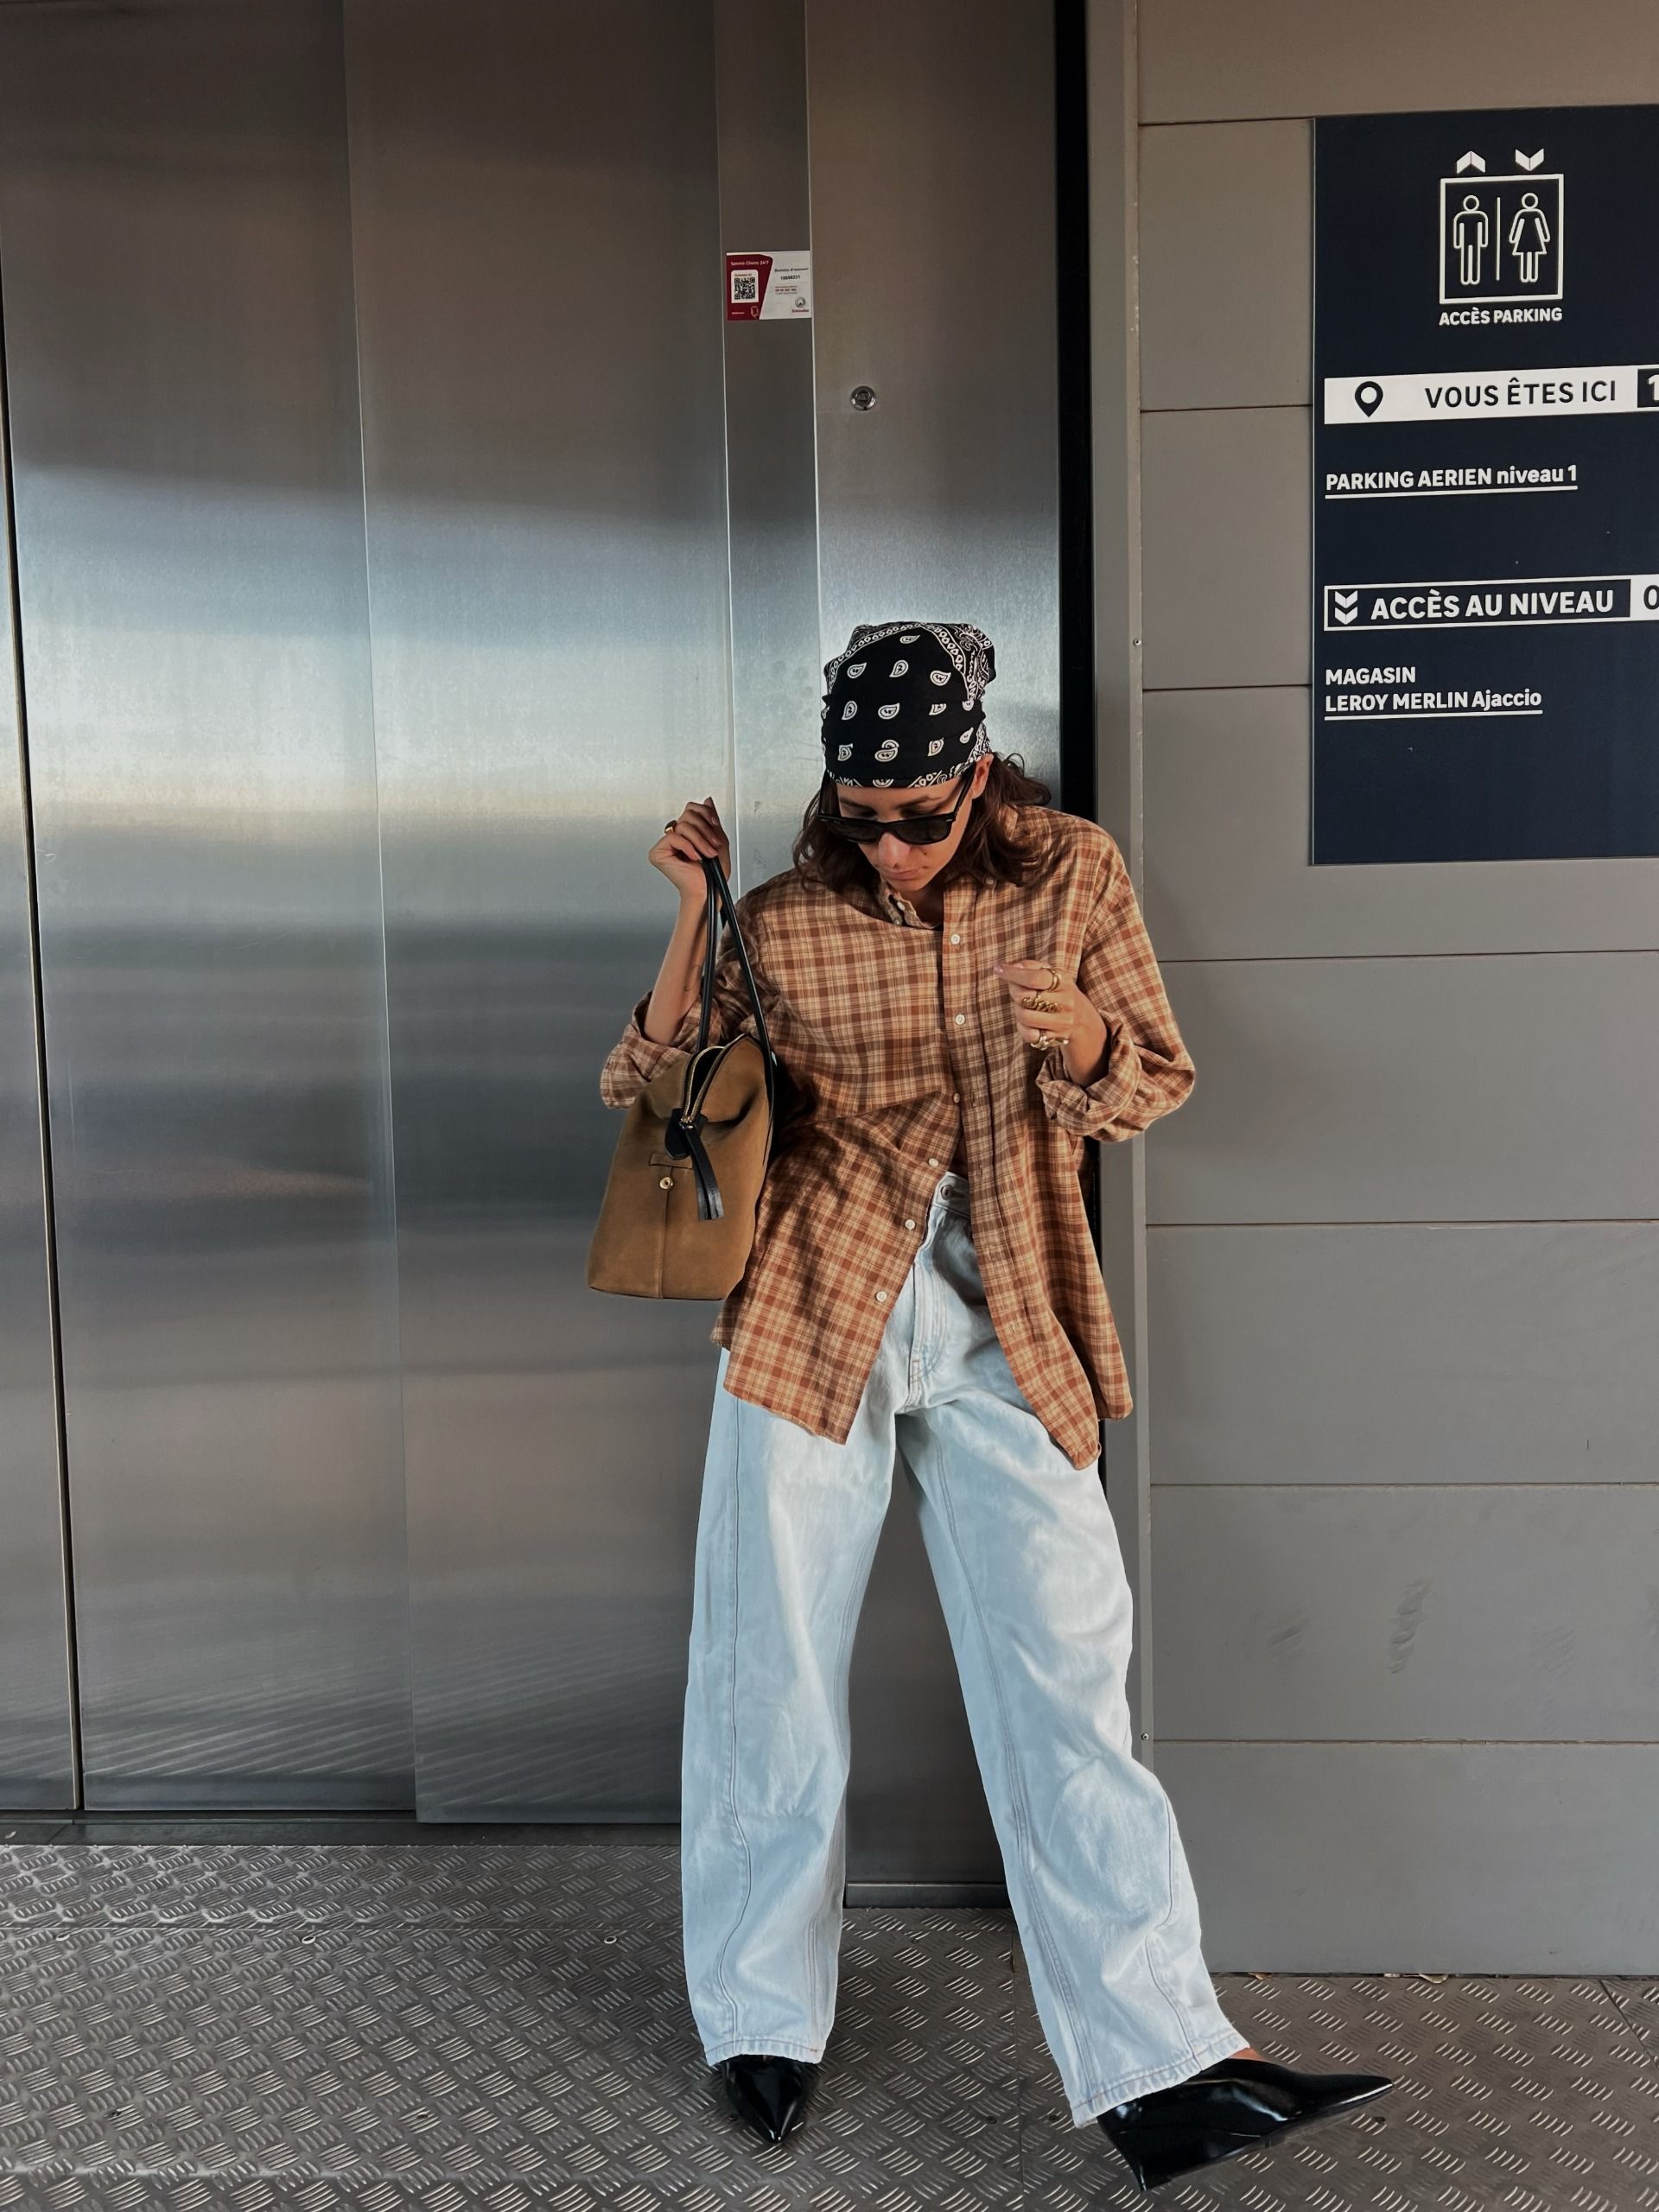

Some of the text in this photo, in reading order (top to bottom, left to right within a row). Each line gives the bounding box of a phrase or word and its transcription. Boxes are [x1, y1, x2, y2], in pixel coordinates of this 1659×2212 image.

[1439, 307, 1562, 326] ACCÈS PARKING
[1425, 377, 1616, 409] VOUS ÊTES ICI
[1326, 465, 1577, 491] PARKING AERIEN niveau 1
[1371, 589, 1613, 620] ACCÈS AU NIVEAU
[1326, 667, 1415, 685] MAGASIN
[1326, 689, 1541, 712] LEROY MERLIN Ajaccio
